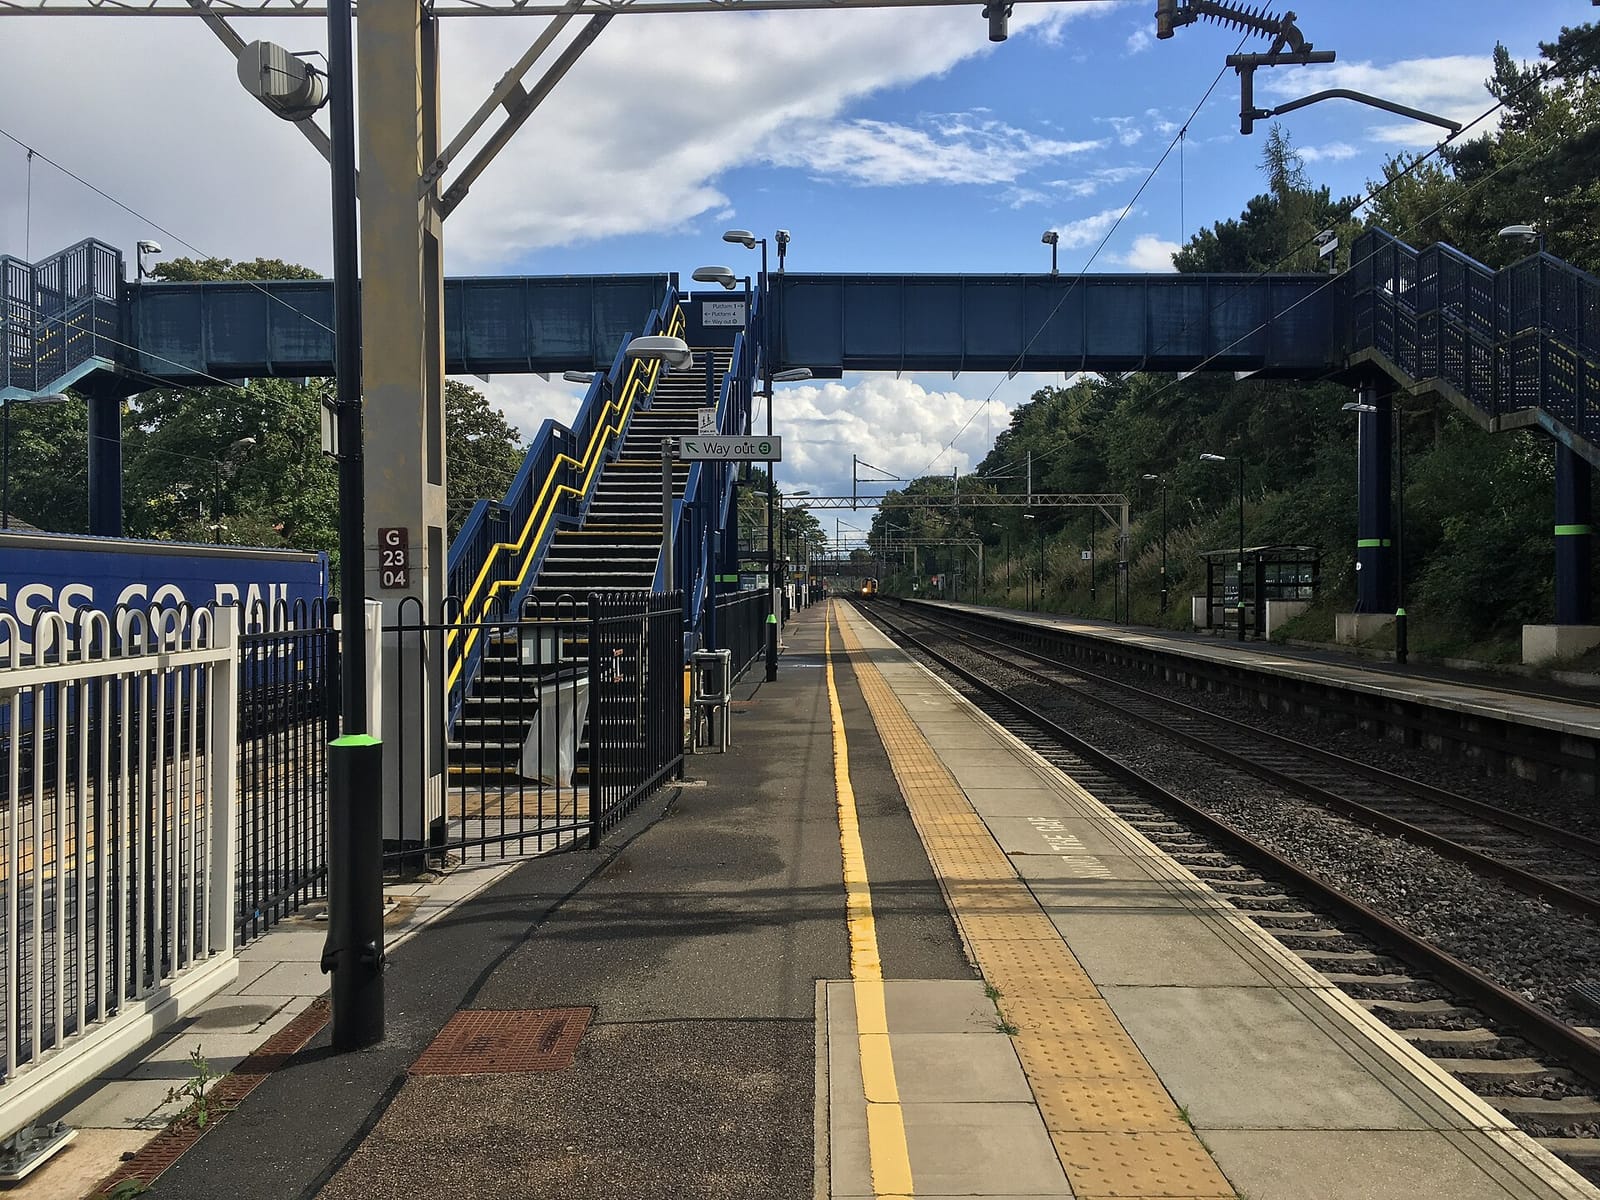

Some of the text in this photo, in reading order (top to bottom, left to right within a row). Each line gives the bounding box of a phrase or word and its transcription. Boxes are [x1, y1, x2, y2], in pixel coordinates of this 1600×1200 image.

[703, 442, 756, 457] Way out
[386, 530, 400, 546] G
[383, 550, 405, 567] 23
[383, 571, 406, 587] 04
[1026, 817, 1068, 832] GAP
[1041, 834, 1087, 851] THE
